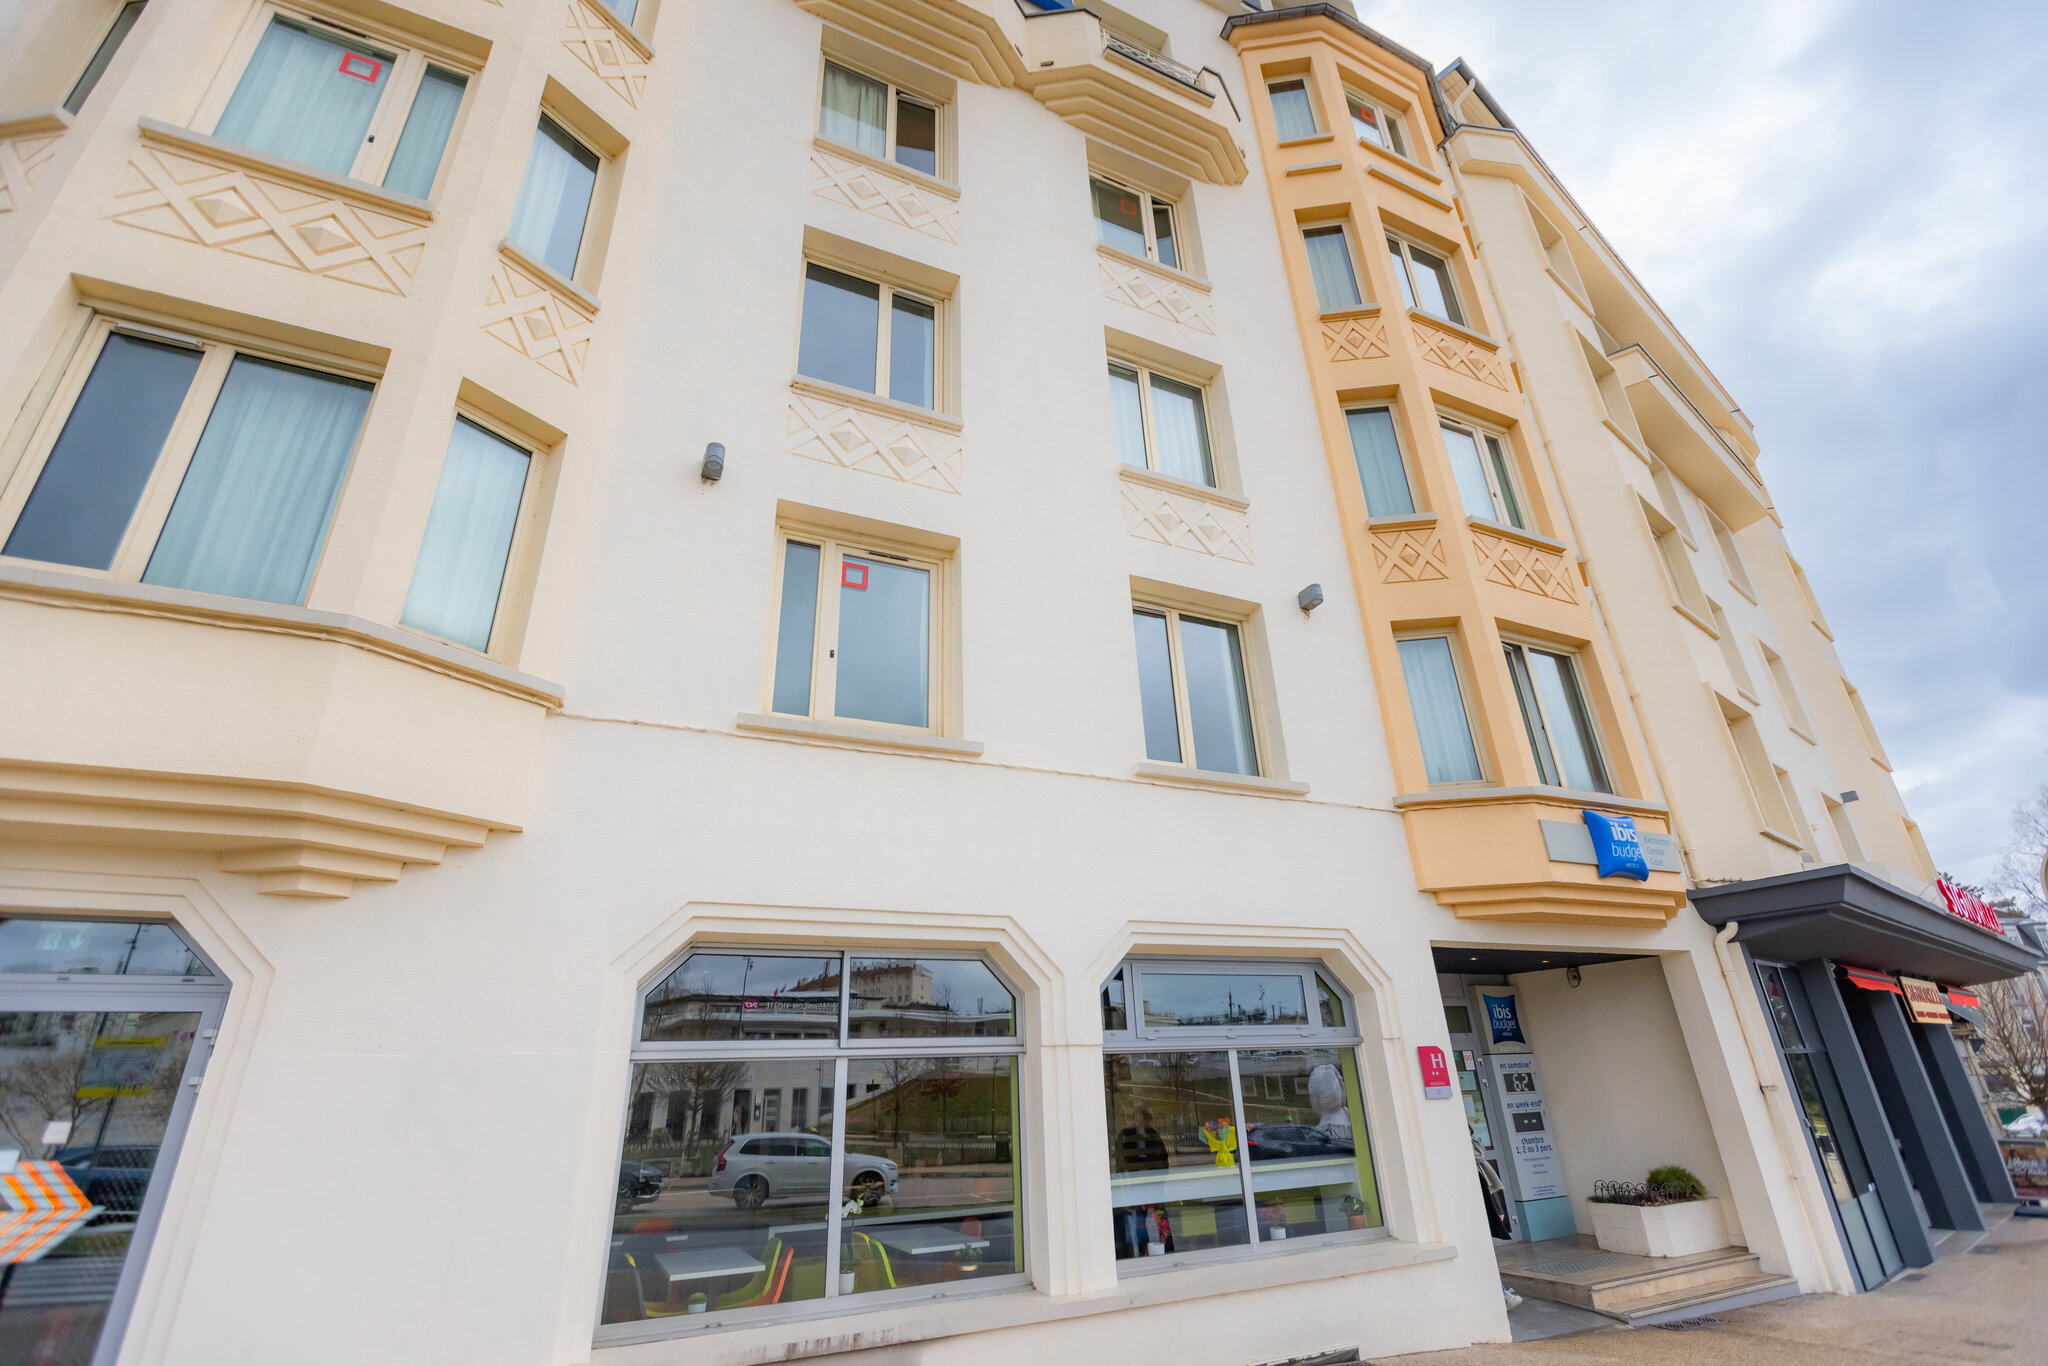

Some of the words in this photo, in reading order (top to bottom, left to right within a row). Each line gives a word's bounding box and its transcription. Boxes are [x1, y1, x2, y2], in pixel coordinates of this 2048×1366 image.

[1609, 821, 1638, 842] ibis
[1611, 842, 1643, 861] budge
[1492, 1004, 1512, 1019] ibis
[1492, 1018, 1517, 1031] budget
[1430, 1053, 1444, 1069] H
[1512, 1073, 1529, 1092] 62
[1507, 1102, 1514, 1110] en
[1521, 1136, 1545, 1145] chambre
[1522, 1145, 1527, 1154] 2
[1535, 1144, 1540, 1152] 3
